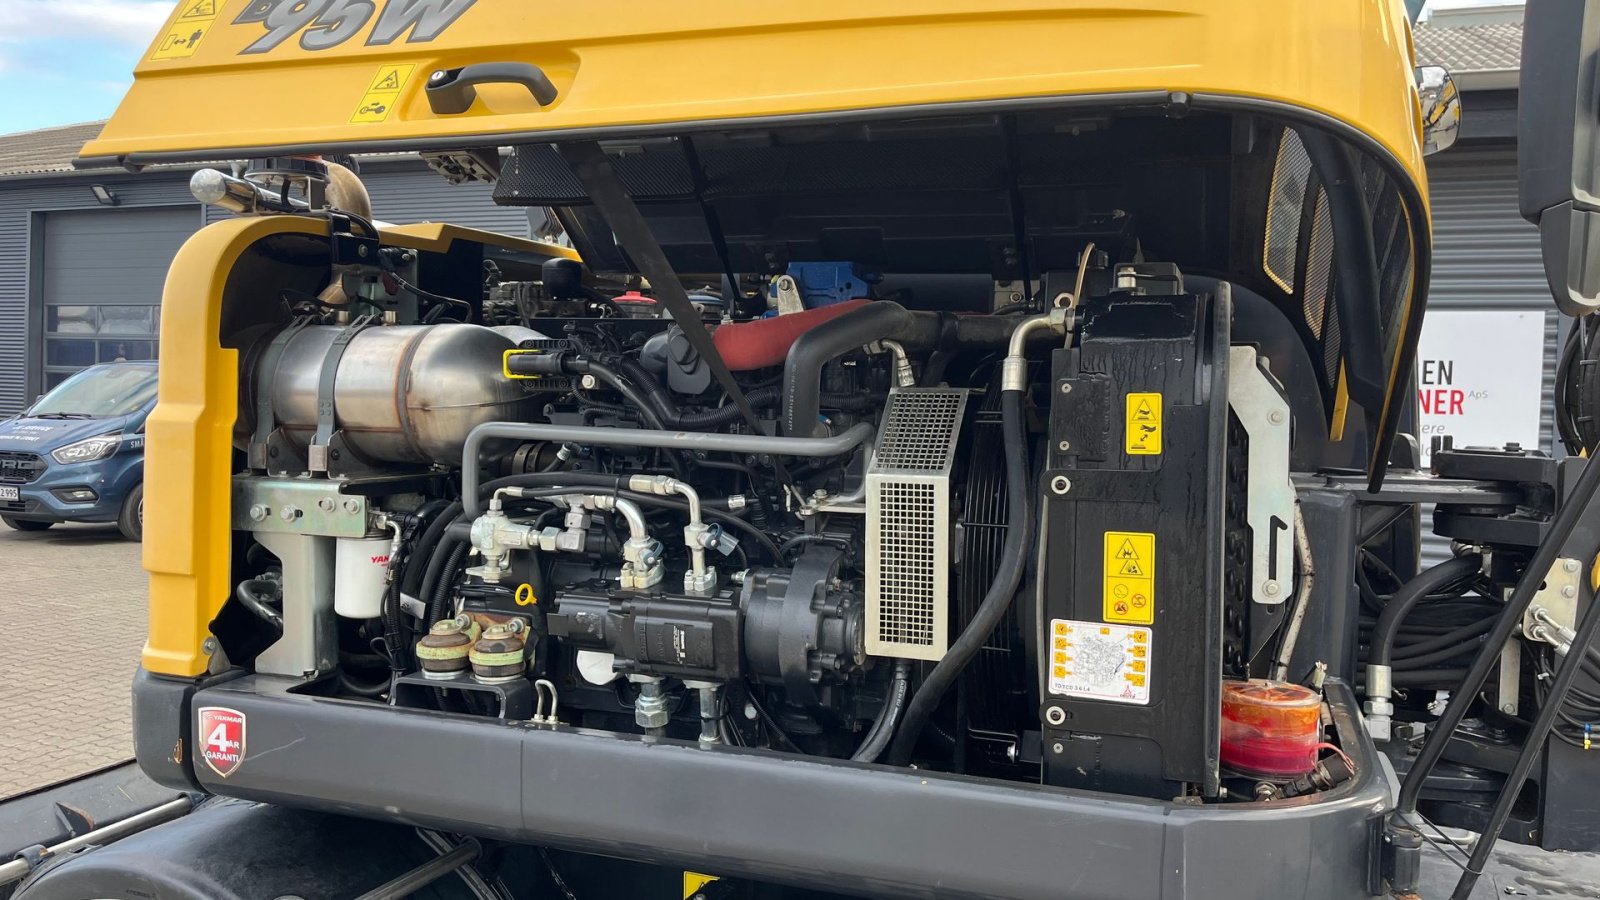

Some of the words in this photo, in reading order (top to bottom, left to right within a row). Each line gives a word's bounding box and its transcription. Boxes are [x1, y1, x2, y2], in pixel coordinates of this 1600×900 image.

[1468, 390, 1488, 400] ApS
[214, 715, 242, 723] YANMAR
[208, 723, 229, 752] 4
[206, 751, 239, 762] GARANTI
